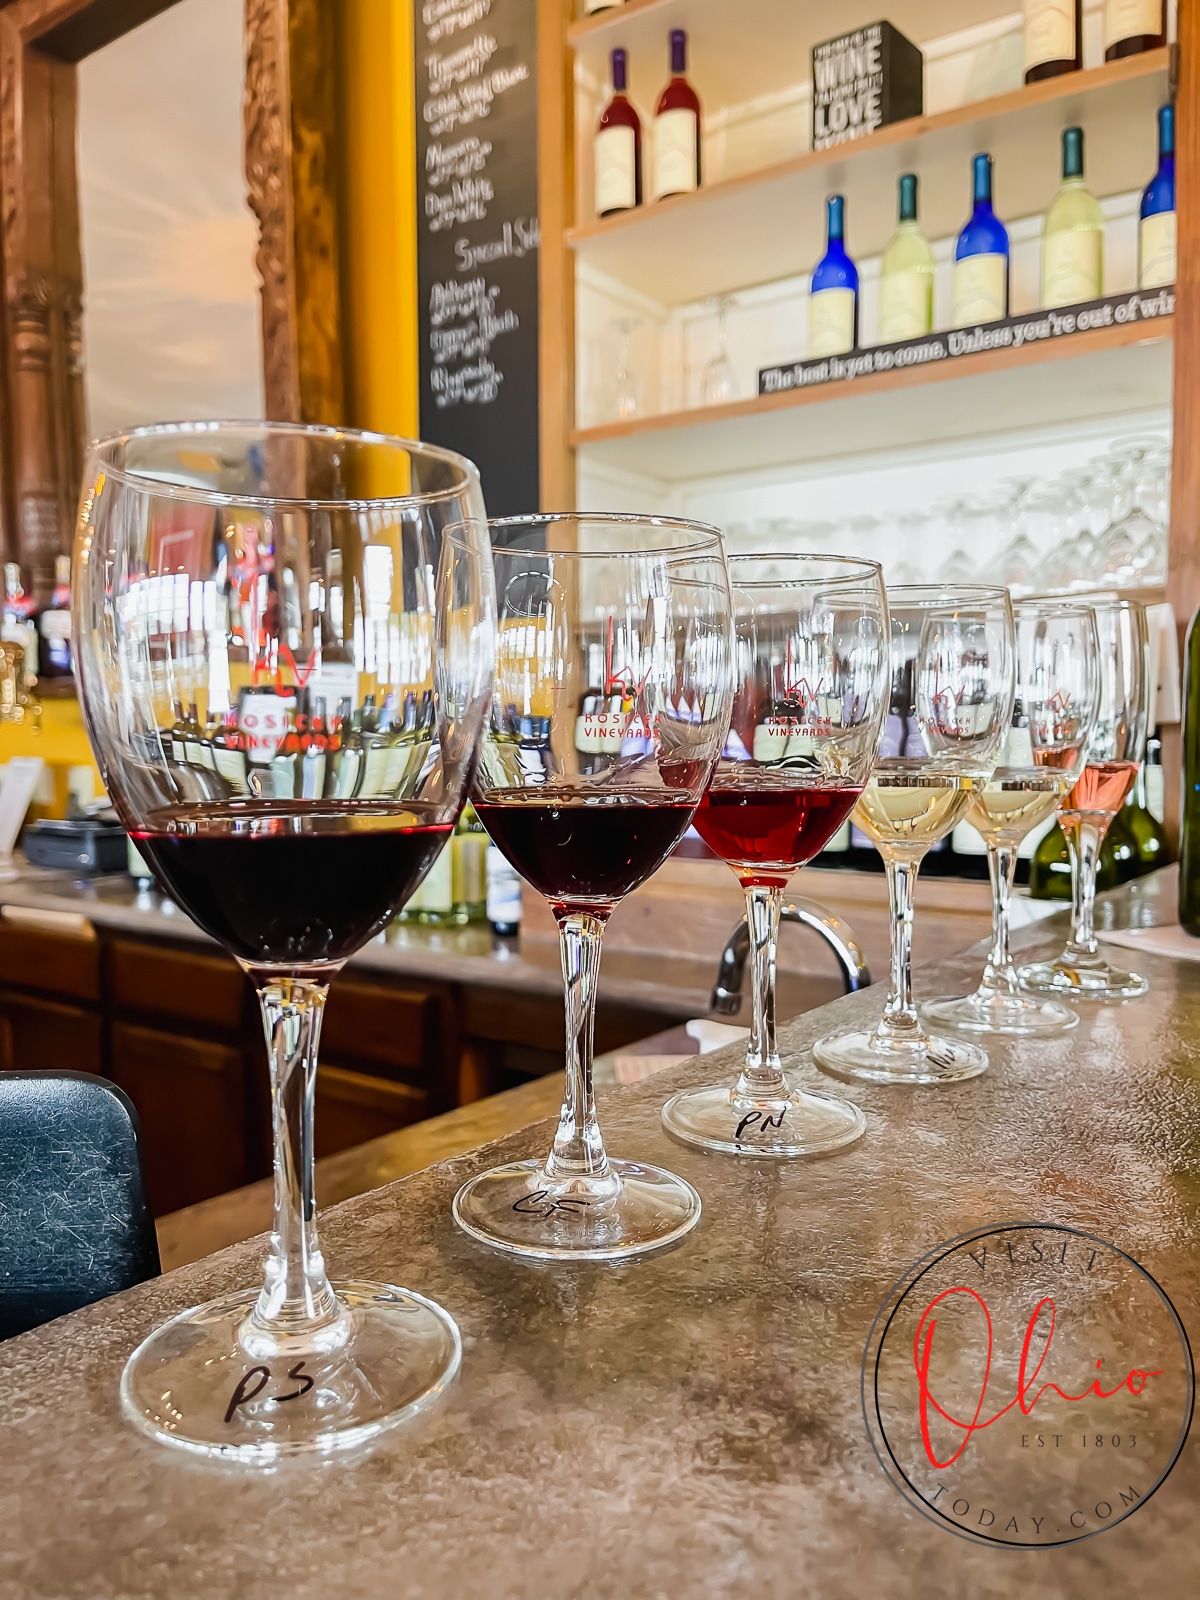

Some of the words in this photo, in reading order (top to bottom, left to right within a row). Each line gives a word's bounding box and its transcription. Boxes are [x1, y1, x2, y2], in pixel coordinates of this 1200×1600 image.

[814, 38, 882, 92] WINE
[815, 90, 882, 138] LOVE
[762, 368, 794, 392] The
[874, 349, 895, 370] to
[948, 327, 1013, 357] Unless
[1012, 313, 1076, 347] you're
[1077, 303, 1114, 331] out
[1115, 294, 1141, 322] of
[584, 727, 661, 738] VINEYARDS
[768, 728, 830, 737] VINEYARDS
[735, 1106, 787, 1138] PN
